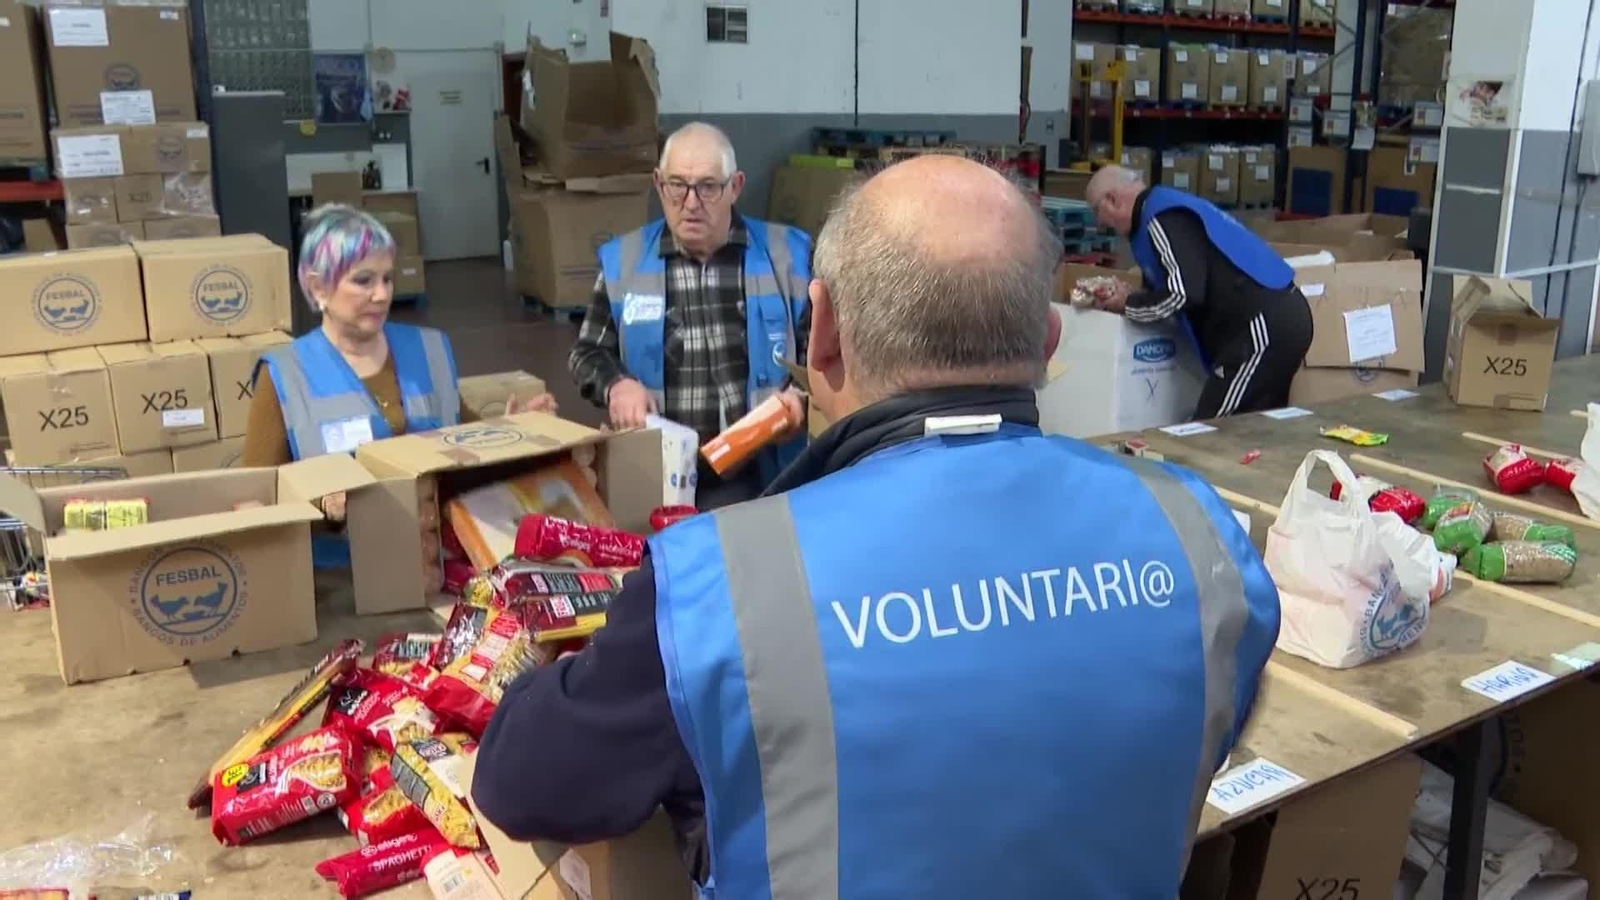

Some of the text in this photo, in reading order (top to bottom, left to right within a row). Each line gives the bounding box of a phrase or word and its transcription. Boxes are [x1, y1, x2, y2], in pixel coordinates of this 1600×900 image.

[1482, 355, 1528, 377] X25
[141, 389, 189, 415] X25
[39, 405, 90, 432] X25
[156, 565, 222, 587] FESBAL
[831, 559, 1175, 650] VOLUNTARI@
[1293, 877, 1361, 900] X25
